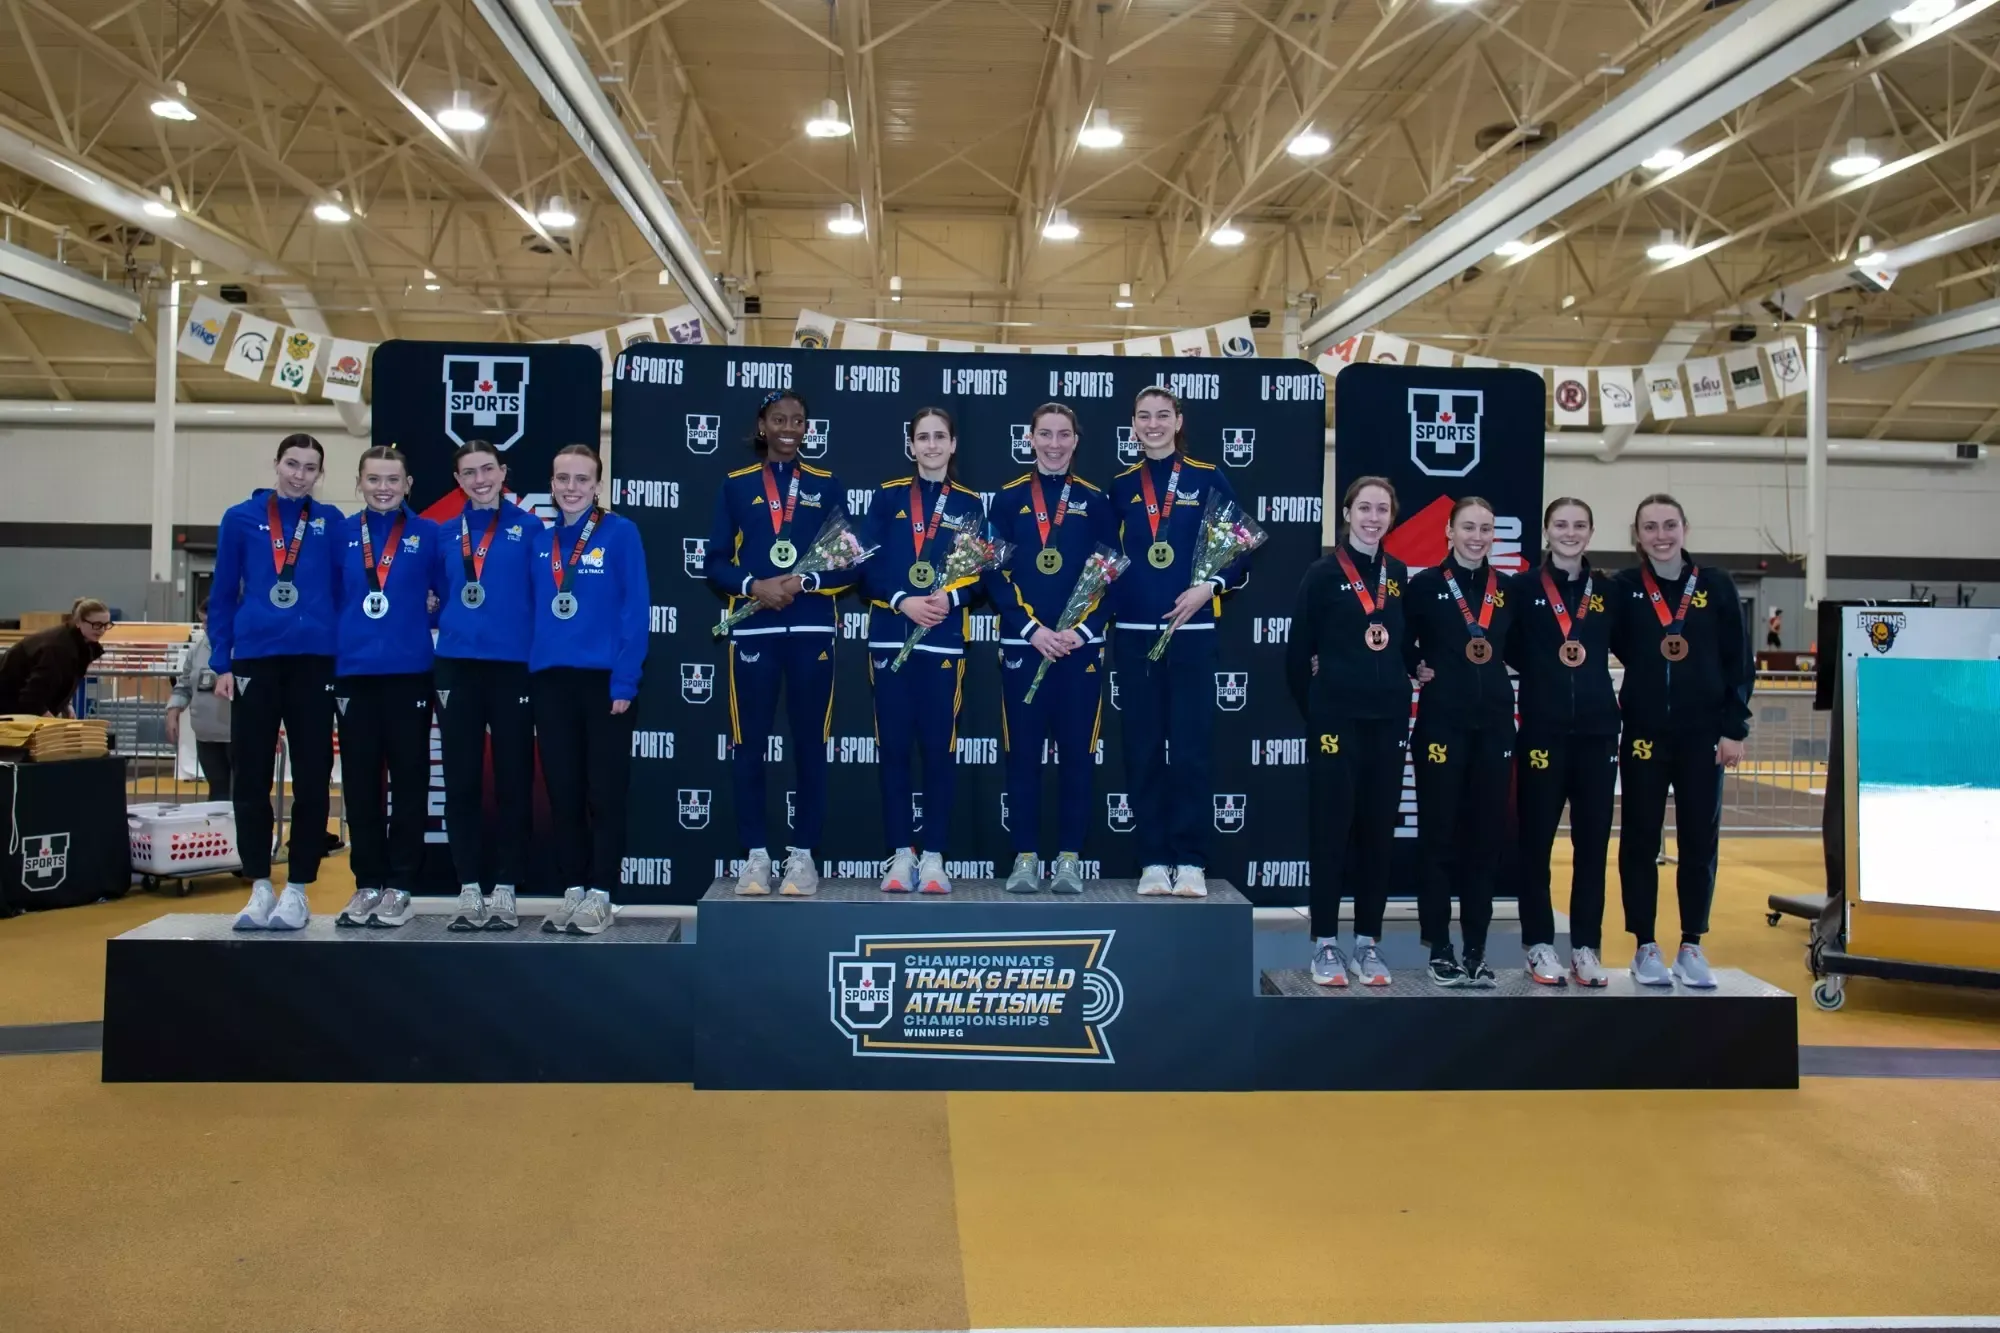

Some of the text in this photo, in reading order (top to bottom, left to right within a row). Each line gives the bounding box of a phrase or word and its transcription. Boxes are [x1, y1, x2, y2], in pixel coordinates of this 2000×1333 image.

[631, 356, 683, 385] SPORTS
[741, 362, 792, 389] SPORTS
[850, 366, 900, 393] SPORTS
[958, 369, 1007, 395] SPORTS
[1064, 371, 1113, 397] SPORTS
[1276, 374, 1325, 400] SPORTS
[451, 395, 519, 412] SPORTS
[688, 429, 717, 440] SPORTS
[803, 435, 826, 443] PORTS
[1416, 424, 1475, 441] SPORTS
[1225, 443, 1252, 452] SPORTS
[628, 480, 678, 508] SPORTS
[1271, 497, 1322, 522] SPORTS
[843, 613, 869, 639] SPO
[969, 615, 1000, 641] ORTS
[1857, 613, 1907, 629] BISONS
[683, 679, 711, 689] SPORTS
[632, 731, 674, 758] PORTS
[956, 738, 997, 764] PORTS
[1266, 739, 1306, 765] SPORT
[680, 805, 708, 815] SPORTS
[1216, 809, 1243, 818] SPORTS
[25, 855, 65, 870] SPORTS
[620, 858, 671, 885] SPORTS
[904, 955, 1055, 967] CHAMPIONNATS
[844, 989, 890, 1002] SPORTS
[904, 988, 1066, 1014] ATHLÉTISME
[904, 1015, 1050, 1027] CHAMPIONSHIPS
[904, 1028, 964, 1038] WINNIPEG
